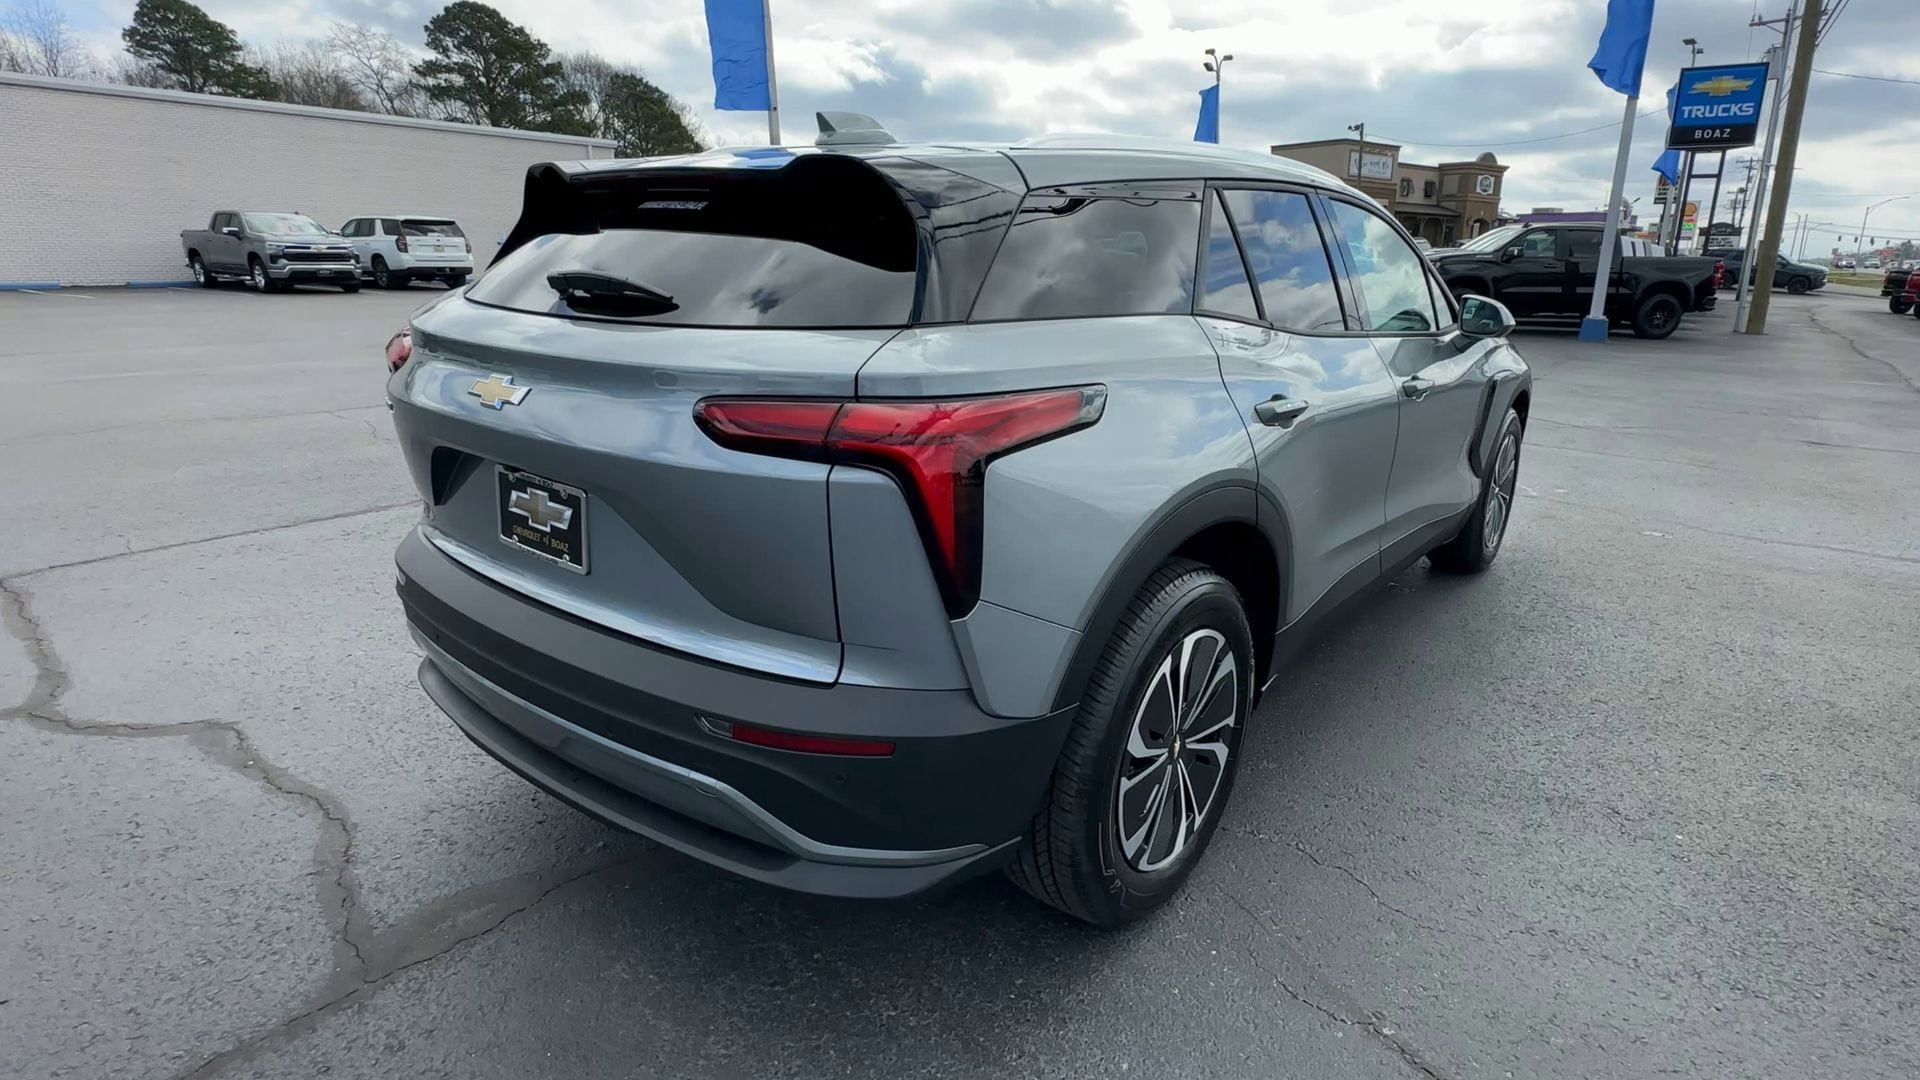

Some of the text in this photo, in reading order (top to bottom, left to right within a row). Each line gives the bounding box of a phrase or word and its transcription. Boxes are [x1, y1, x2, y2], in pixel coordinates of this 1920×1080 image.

[1682, 102, 1755, 119] TRUCKS
[1694, 128, 1731, 139] BOAZ
[512, 524, 541, 543] CHEVROLET
[551, 538, 569, 552] BOAZ
